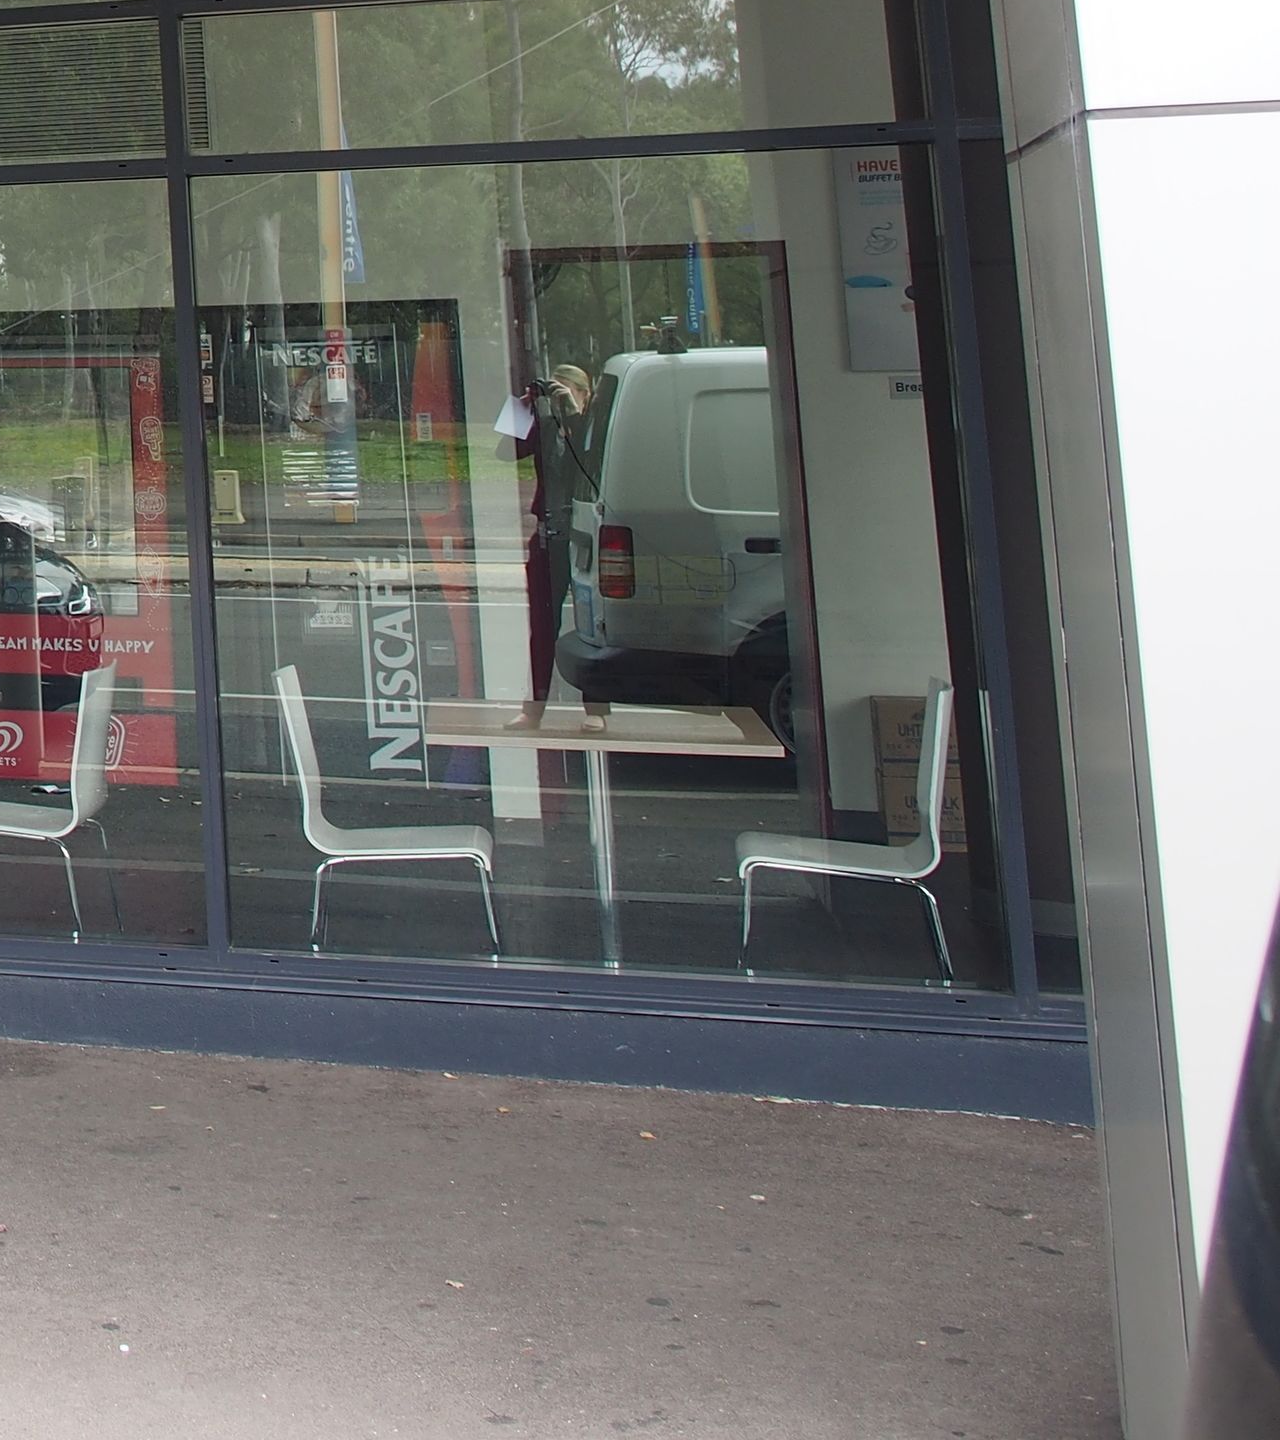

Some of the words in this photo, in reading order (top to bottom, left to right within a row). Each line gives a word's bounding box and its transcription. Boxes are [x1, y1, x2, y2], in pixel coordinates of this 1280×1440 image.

[857, 160, 898, 172] HAVE
[342, 190, 356, 273] entre
[272, 339, 377, 366] NESCAFÉ
[32, 636, 83, 652] MAKES
[88, 638, 99, 652] U
[104, 639, 154, 654] HAPPY
[354, 554, 422, 772] NESCAFÉ
